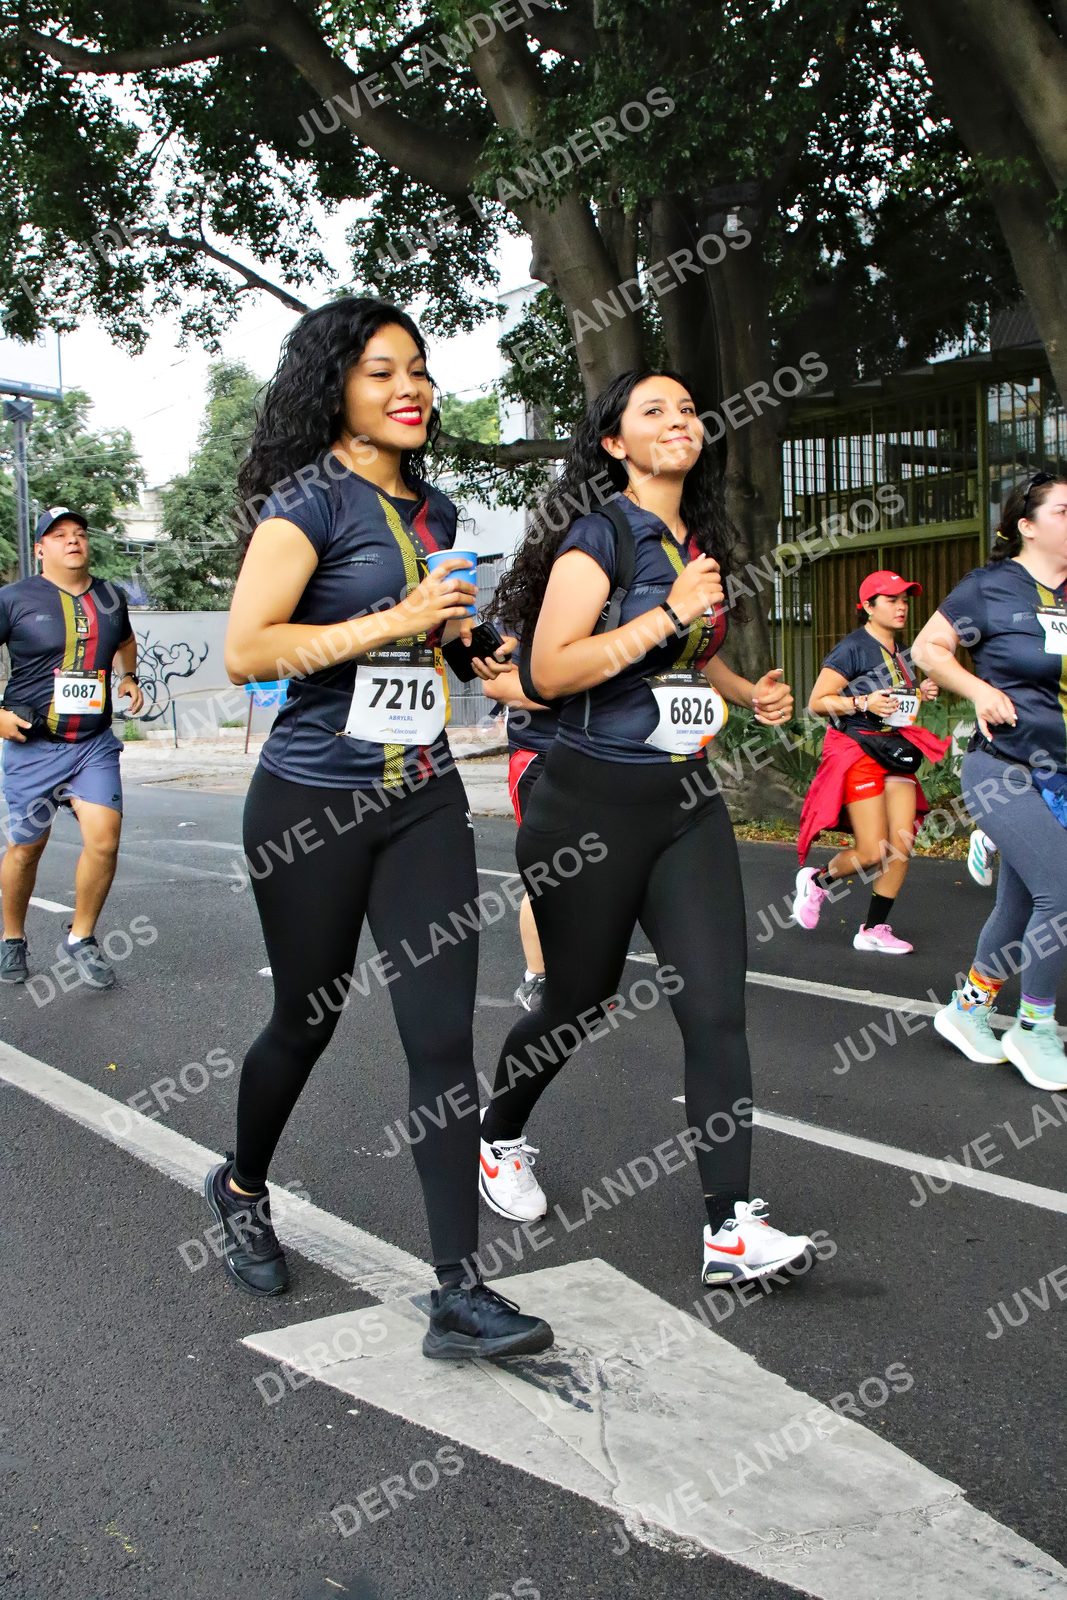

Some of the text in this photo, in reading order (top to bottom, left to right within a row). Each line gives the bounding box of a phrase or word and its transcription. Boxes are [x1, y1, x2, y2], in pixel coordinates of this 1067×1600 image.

[62, 684, 97, 698] 6087
[368, 677, 436, 711] 7216
[670, 697, 714, 725] 6826
[899, 701, 915, 713] 437
